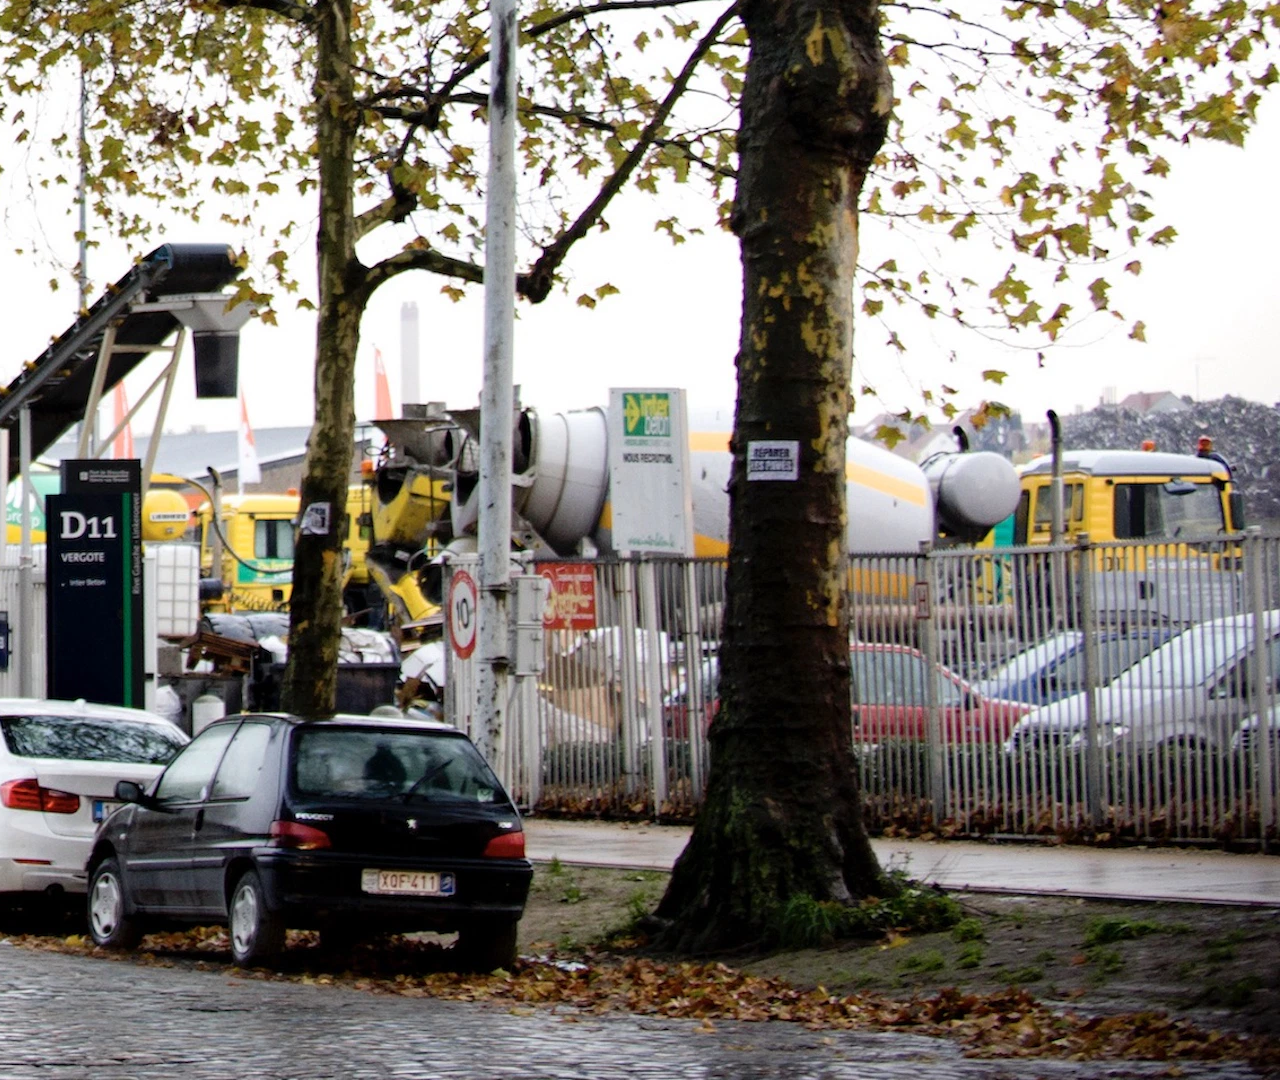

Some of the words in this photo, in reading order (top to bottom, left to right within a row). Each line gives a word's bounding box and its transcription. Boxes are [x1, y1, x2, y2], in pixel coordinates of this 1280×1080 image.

[60, 511, 117, 539] D11
[60, 552, 105, 563] VERGOTE
[456, 598, 469, 631] 10
